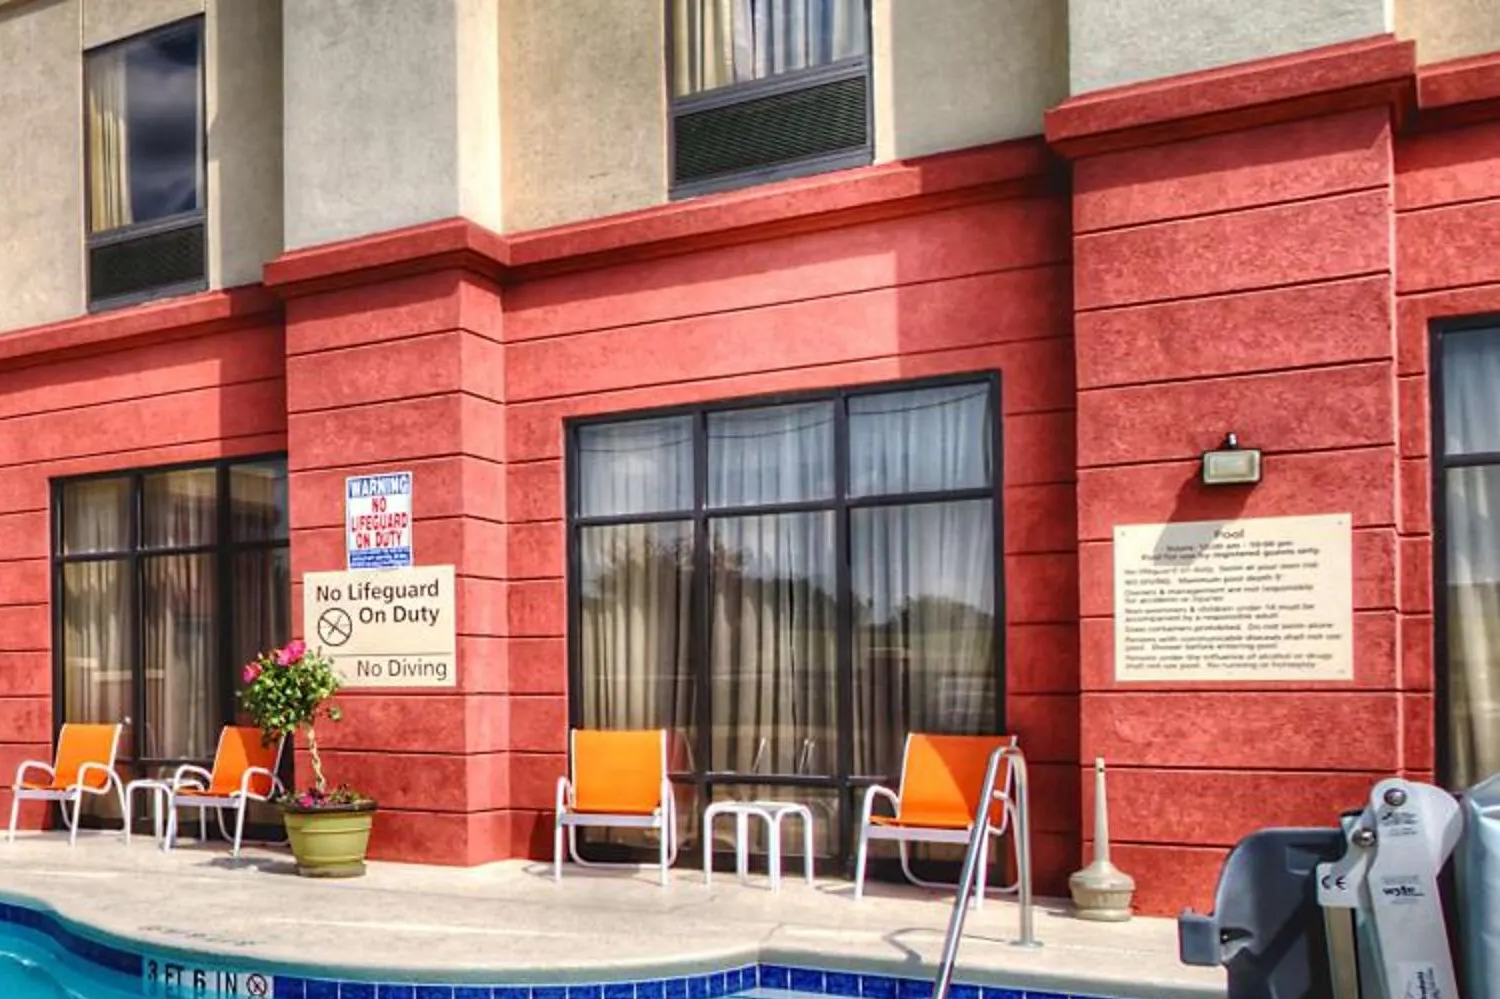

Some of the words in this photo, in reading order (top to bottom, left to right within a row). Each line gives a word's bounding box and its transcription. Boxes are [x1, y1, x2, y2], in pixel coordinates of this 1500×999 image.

[351, 475, 409, 497] WARNING
[372, 497, 387, 512] NO
[352, 512, 408, 532] LIFEGUARD
[356, 533, 370, 548] ON
[376, 531, 402, 546] DUTY
[1214, 529, 1244, 539] Pool
[316, 585, 341, 603] No
[349, 579, 439, 603] Lifeguard
[359, 607, 386, 624] On
[393, 606, 440, 627] Duty
[357, 660, 382, 678] No
[388, 659, 447, 680] Diving
